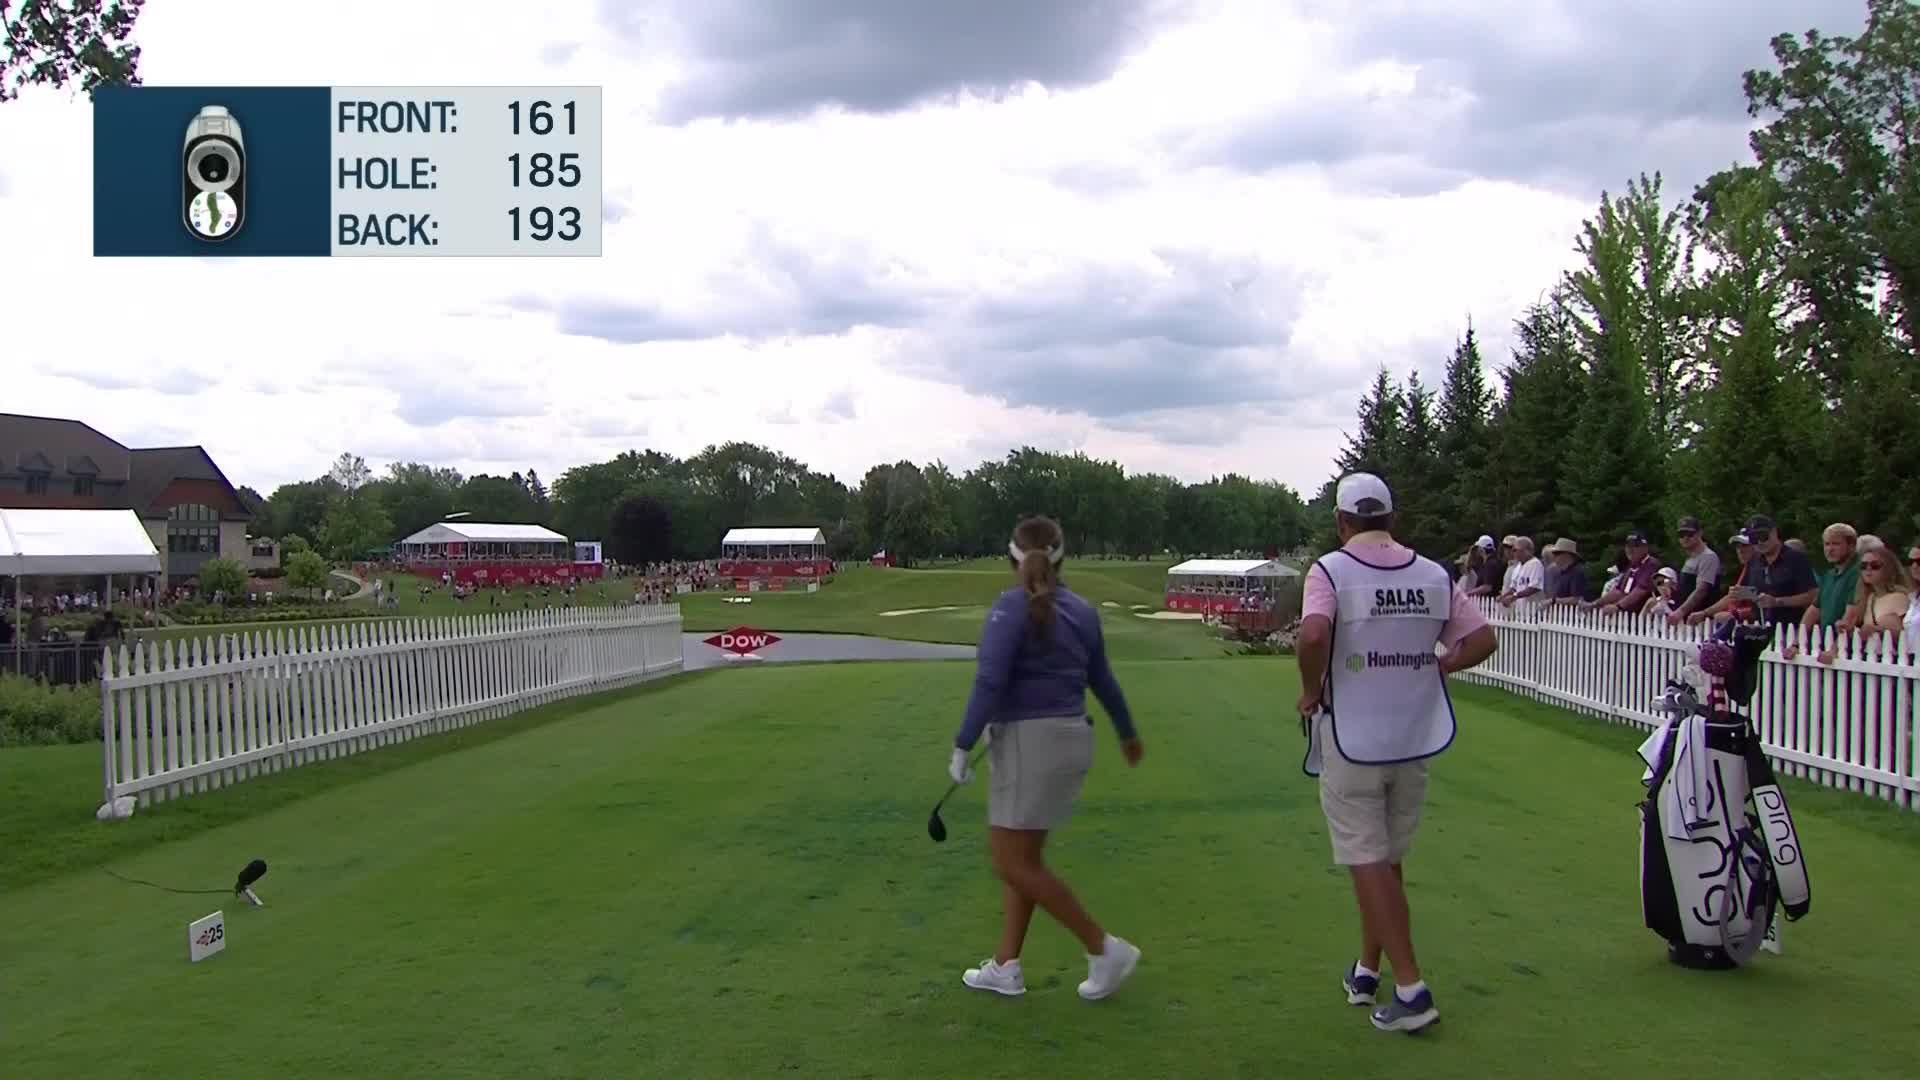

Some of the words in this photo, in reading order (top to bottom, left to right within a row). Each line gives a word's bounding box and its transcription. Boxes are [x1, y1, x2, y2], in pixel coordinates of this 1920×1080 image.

[1375, 589, 1425, 606] SALAS
[721, 634, 767, 648] DOW
[209, 923, 223, 944] 25
